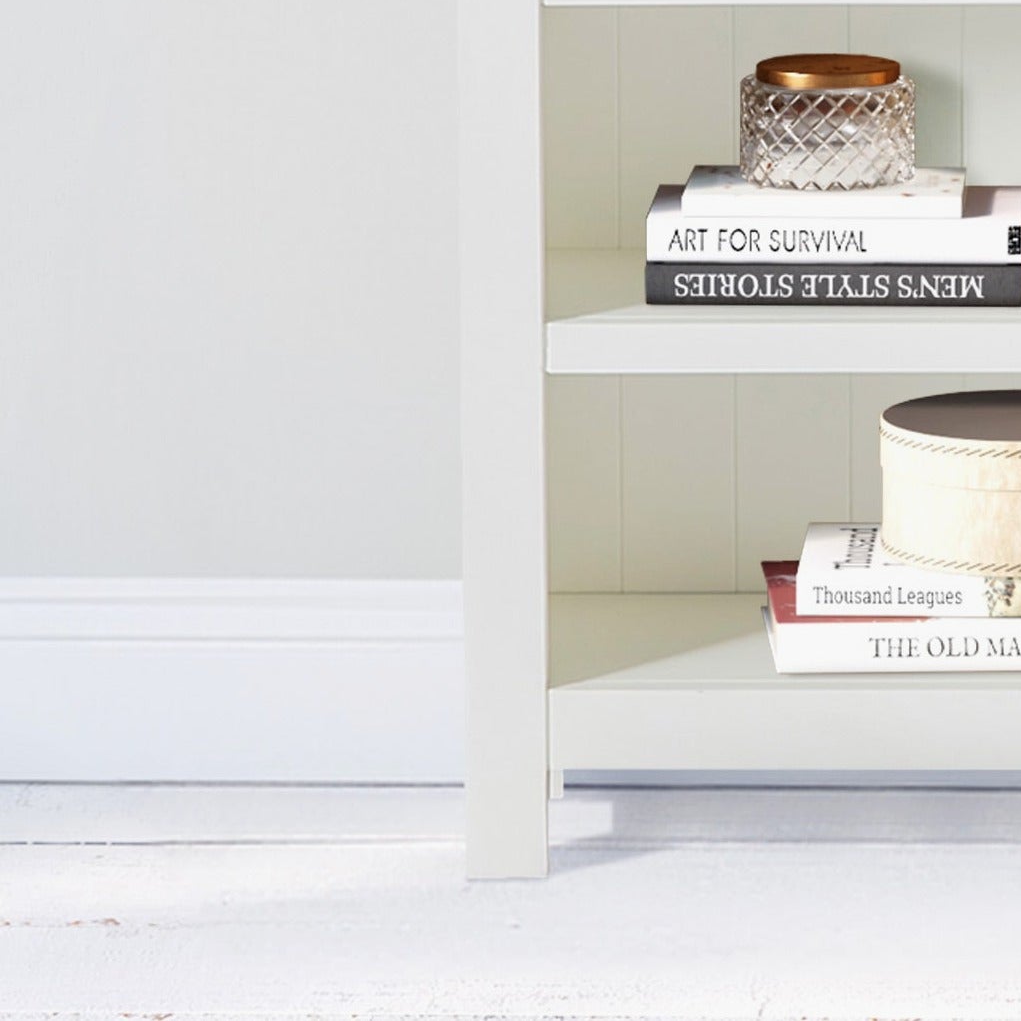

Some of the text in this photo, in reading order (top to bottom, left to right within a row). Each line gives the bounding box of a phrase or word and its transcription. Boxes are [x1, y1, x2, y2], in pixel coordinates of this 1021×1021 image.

[668, 228, 867, 253] ART FOR SURVIVAL
[673, 273, 985, 299] MEN'S STYLE STORIES
[813, 585, 963, 609] Thousand Leagues
[869, 636, 920, 658] THE
[926, 636, 979, 658] OLD
